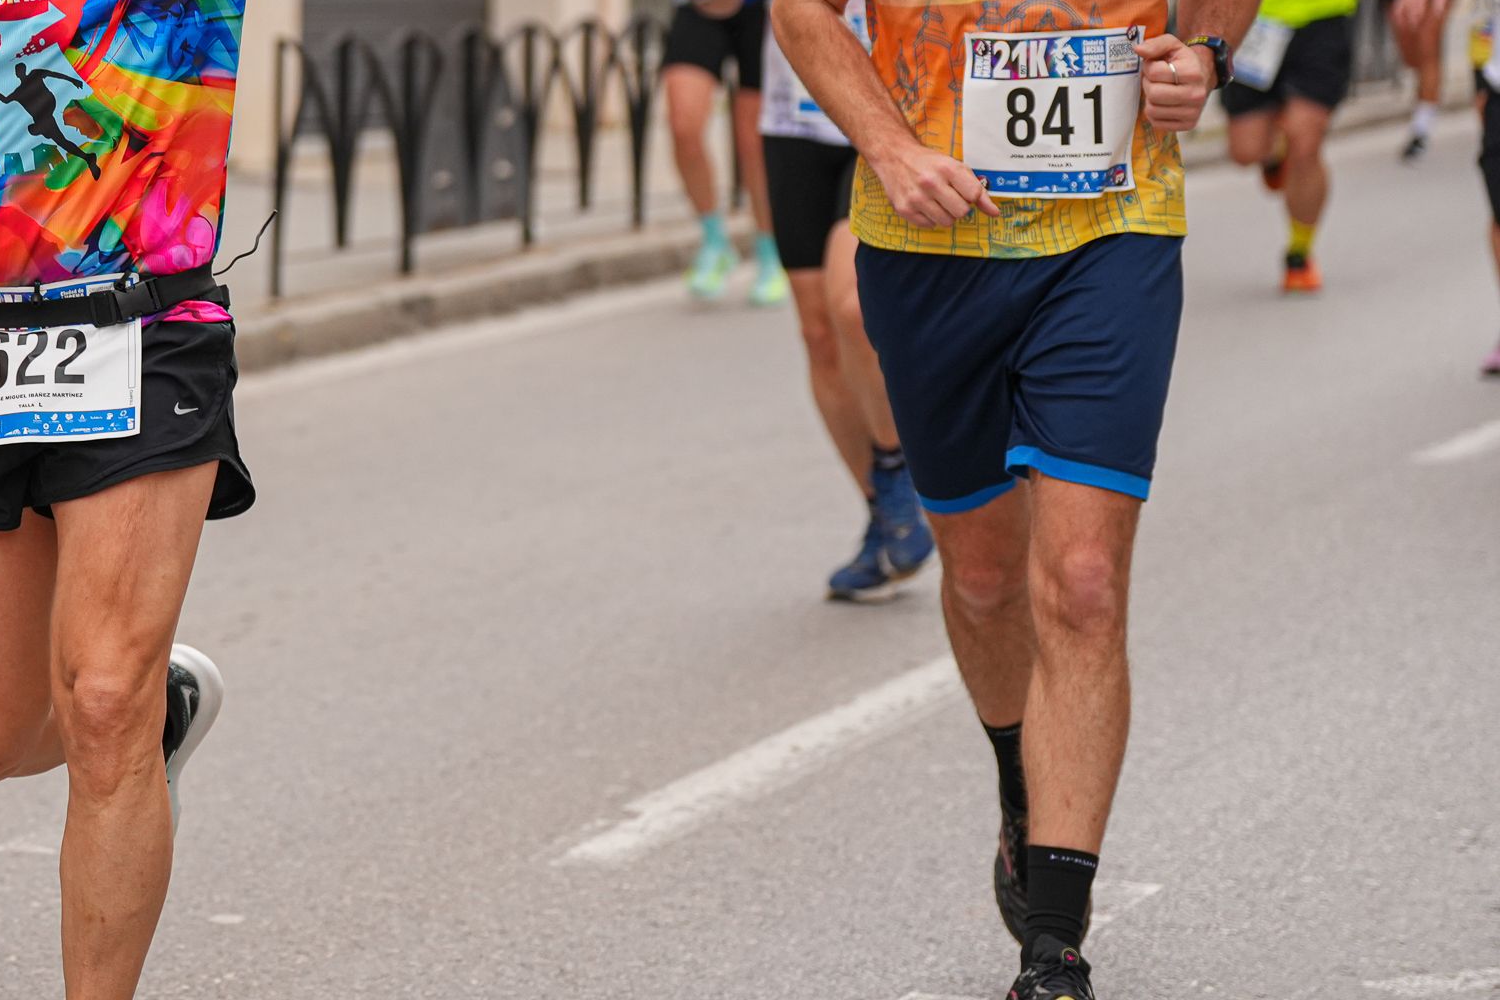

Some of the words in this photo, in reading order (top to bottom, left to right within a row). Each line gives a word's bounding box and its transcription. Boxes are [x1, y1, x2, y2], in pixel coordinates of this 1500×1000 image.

[992, 39, 1050, 79] 21K
[1084, 60, 1105, 74] 2026
[1006, 85, 1103, 147] 841
